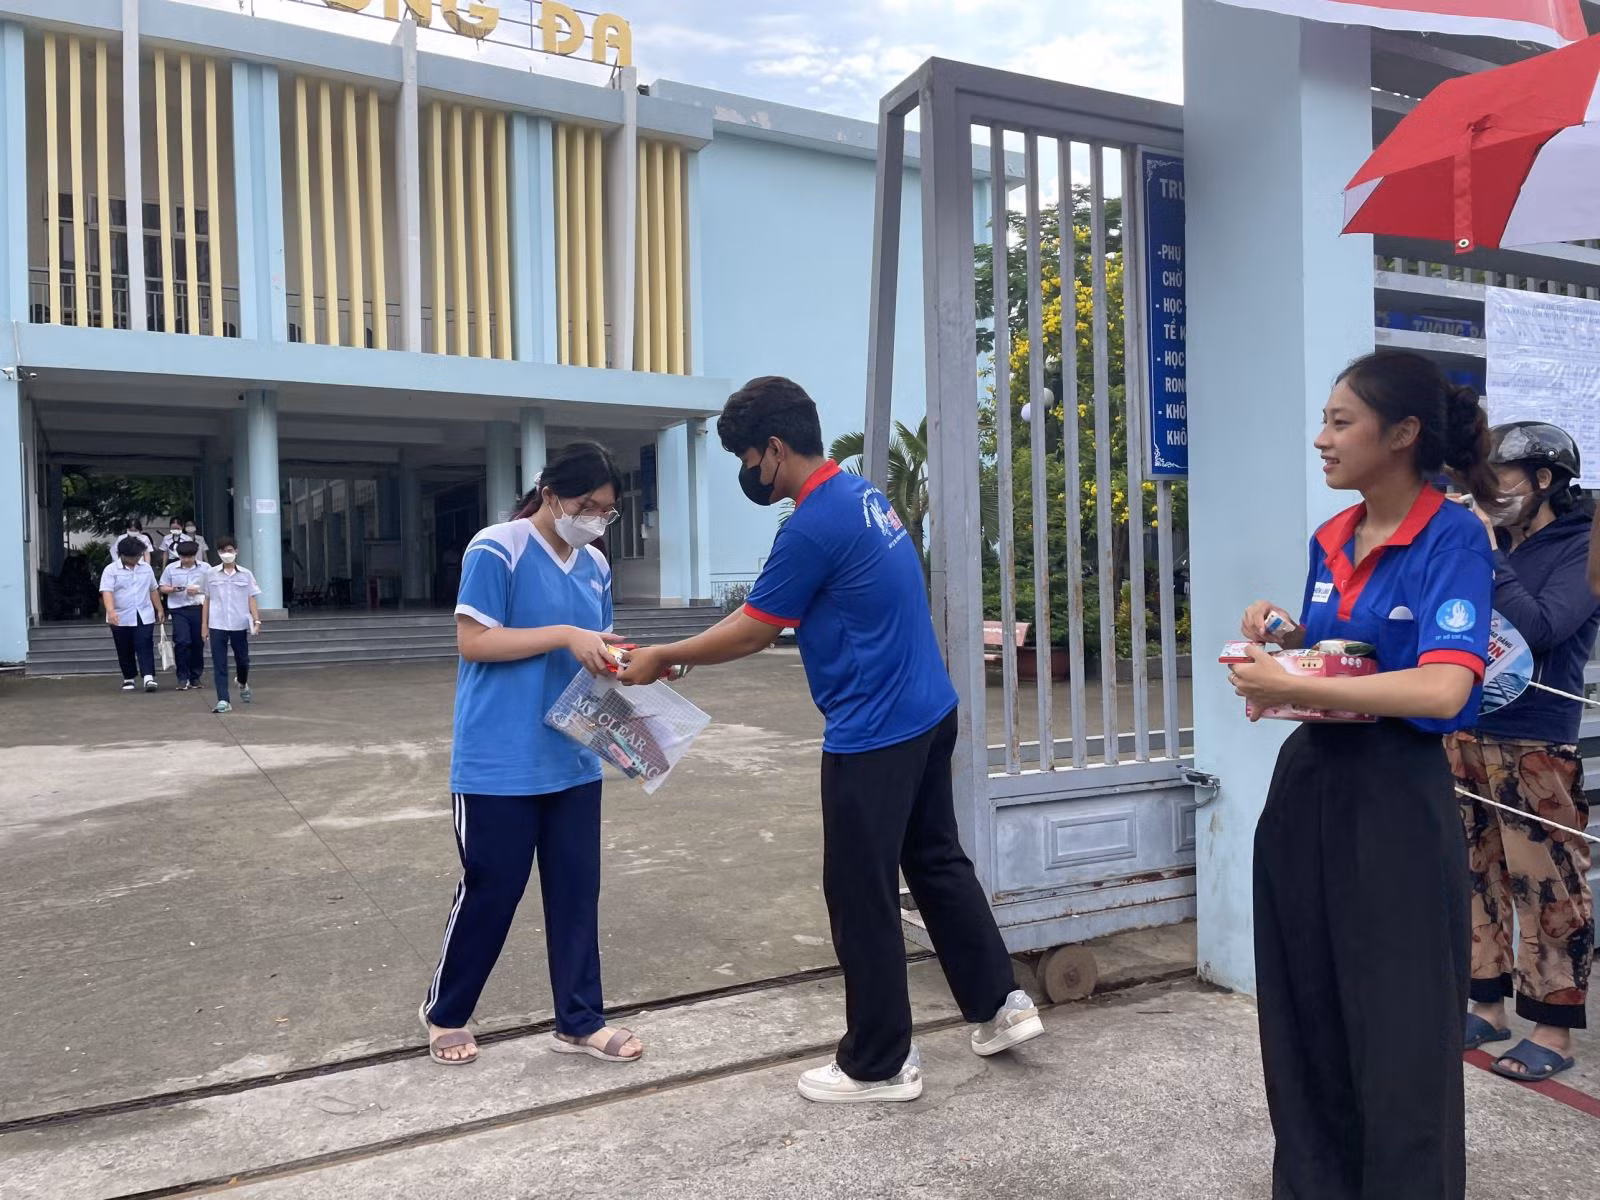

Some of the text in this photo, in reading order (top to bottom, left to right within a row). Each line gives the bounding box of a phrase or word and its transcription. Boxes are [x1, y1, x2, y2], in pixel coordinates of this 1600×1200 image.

[538, 0, 632, 66] ĐA
[1162, 268, 1183, 288] CHỜ
[1163, 297, 1183, 316] HỌC
[1164, 350, 1185, 370] HỌC
[1165, 377, 1186, 394] RON
[1166, 401, 1187, 420] KHÔ
[1166, 427, 1188, 446] KHÔ
[598, 713, 647, 752] CLEAR
